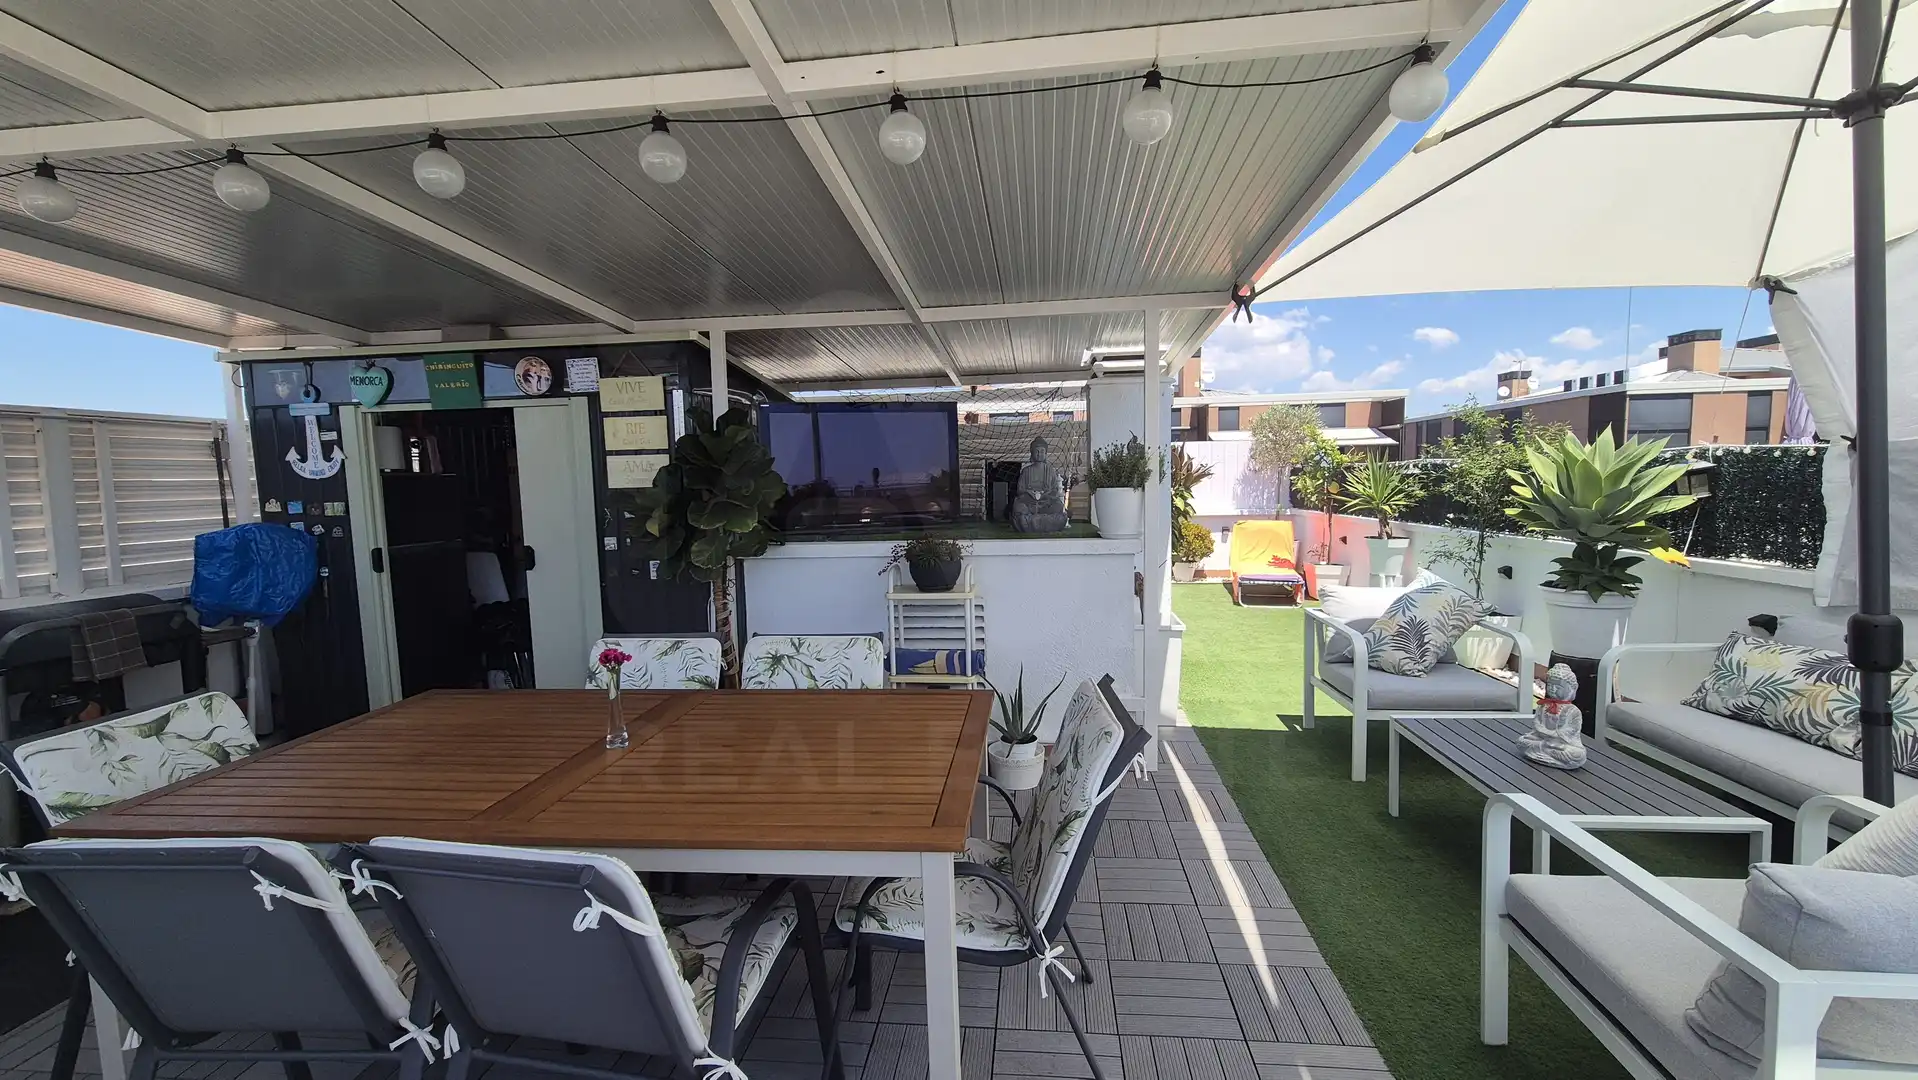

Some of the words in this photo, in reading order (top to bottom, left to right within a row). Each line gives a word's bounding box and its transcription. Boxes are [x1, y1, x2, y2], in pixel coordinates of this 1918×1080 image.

[350, 376, 384, 387] MENORCA
[434, 380, 470, 388] VALERIO
[615, 381, 646, 394] VIVE
[625, 422, 647, 435] RIE
[307, 419, 320, 469] WELCOME
